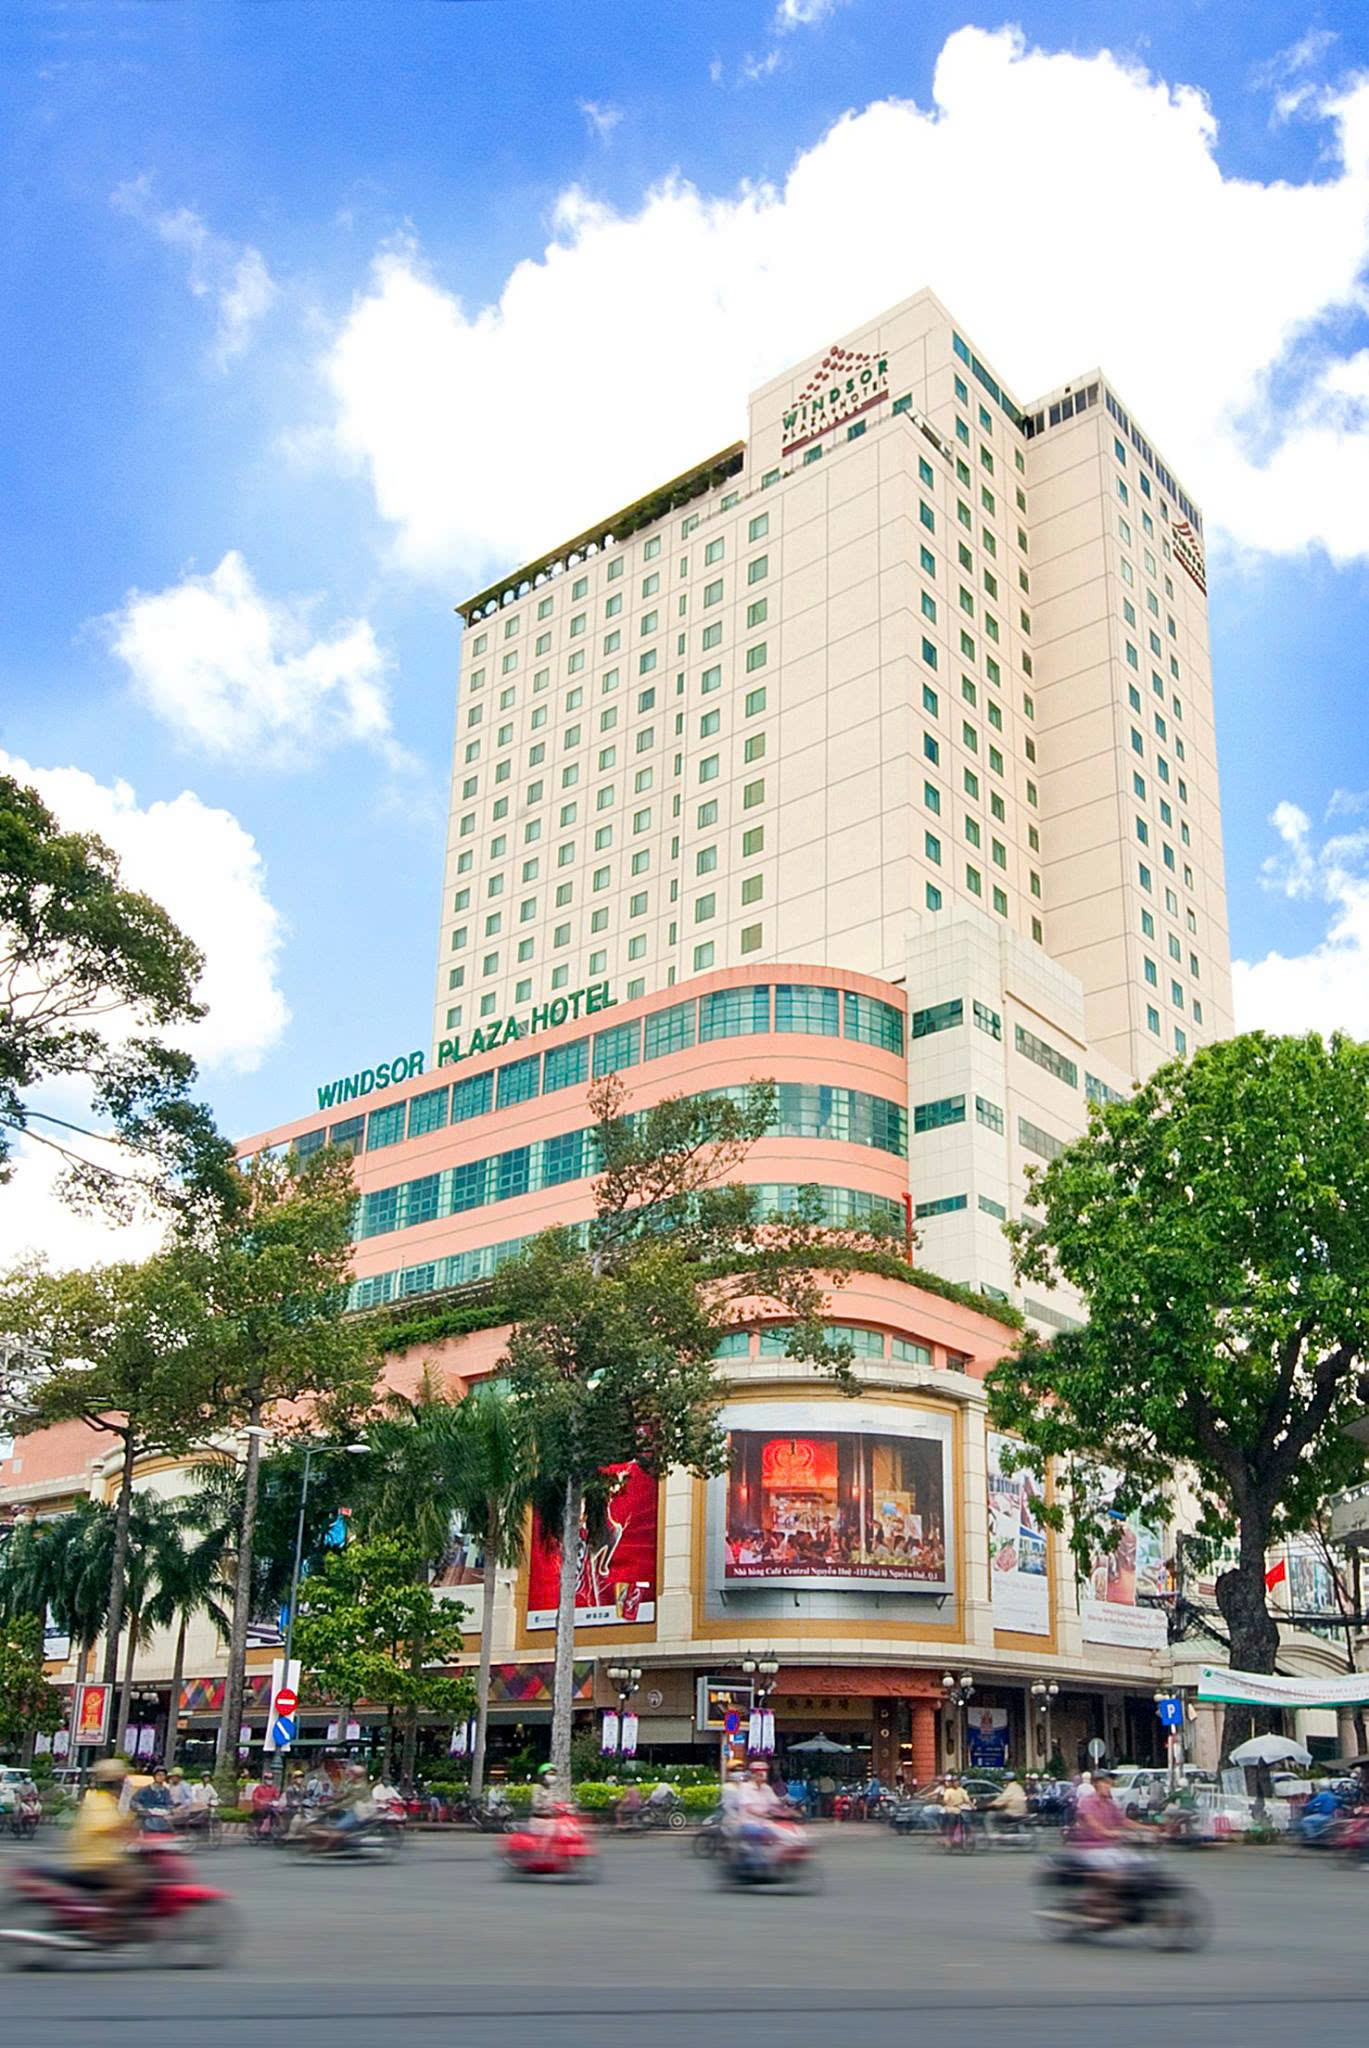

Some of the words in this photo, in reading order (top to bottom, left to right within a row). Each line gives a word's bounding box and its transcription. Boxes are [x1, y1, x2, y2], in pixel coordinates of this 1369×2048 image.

[783, 359, 888, 431] WINDSOR
[783, 411, 827, 442] PLAZA
[839, 375, 888, 410] HOTEL
[317, 1050, 425, 1110] WINDSOR
[437, 1015, 520, 1068] PLAZA
[530, 980, 618, 1034] HOTEL
[1167, 1704, 1176, 1719] P
